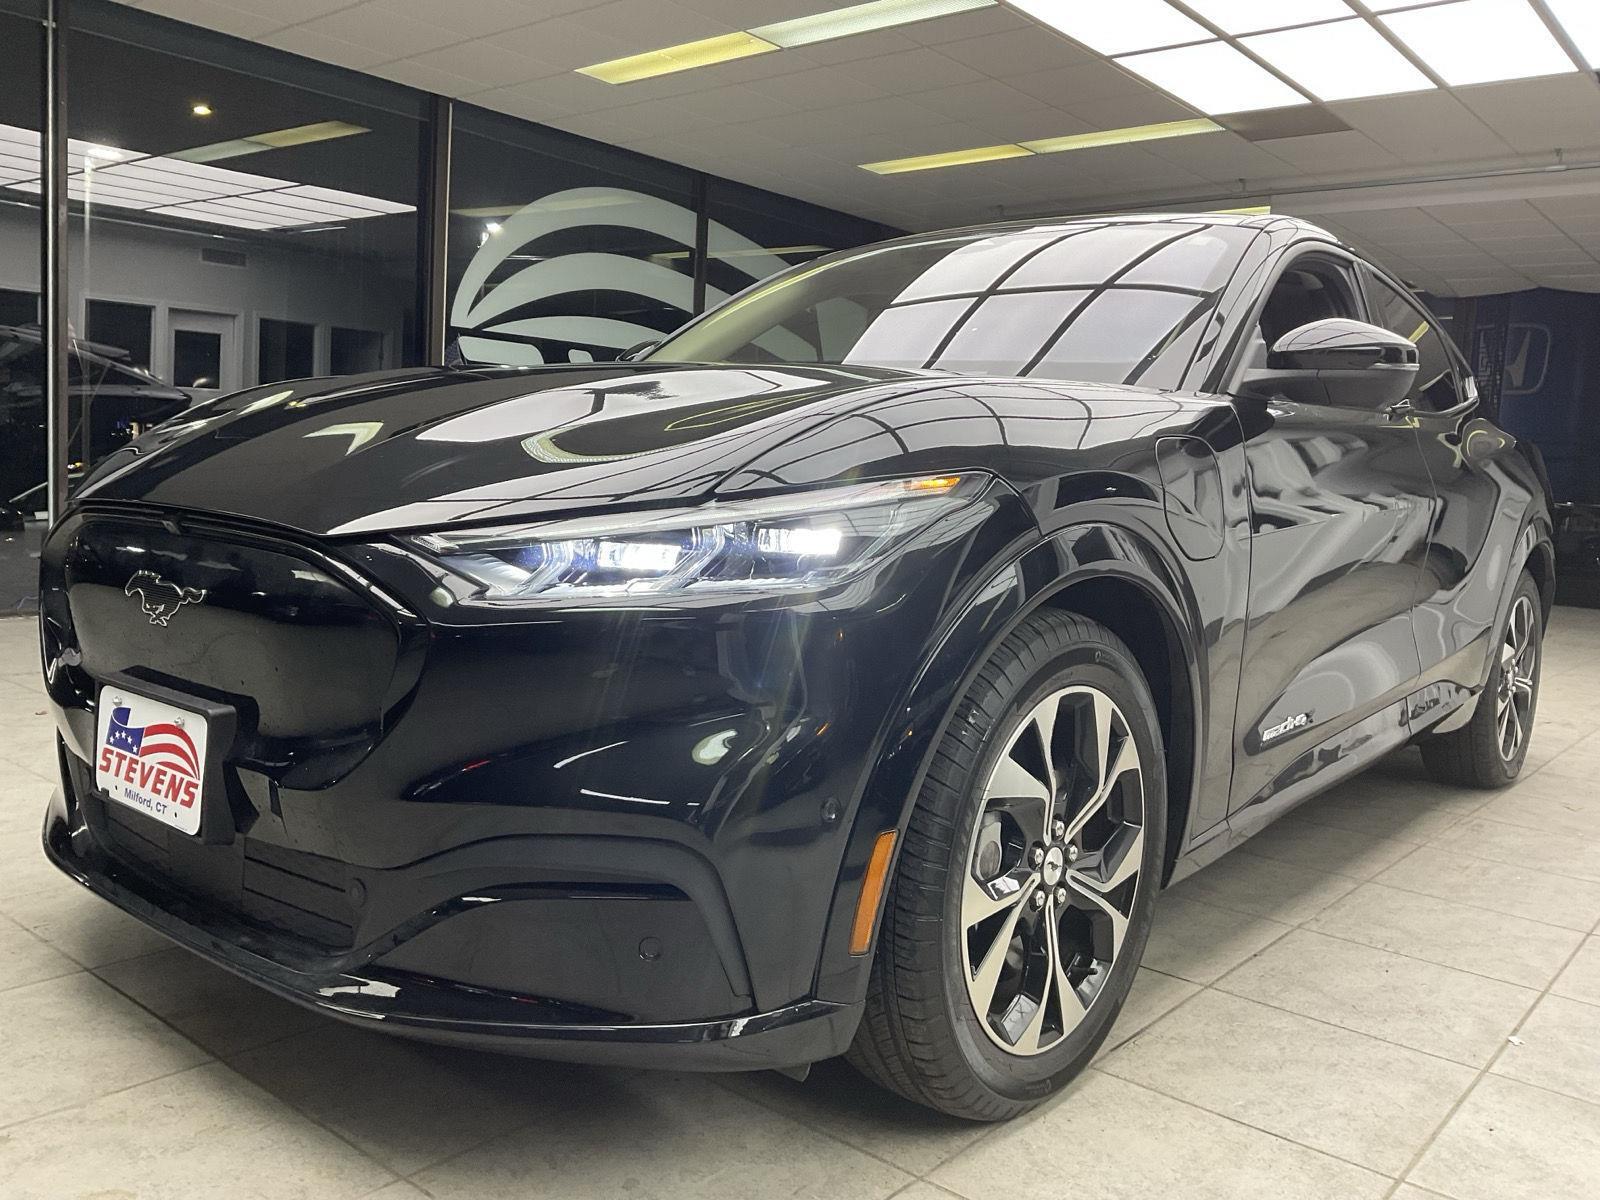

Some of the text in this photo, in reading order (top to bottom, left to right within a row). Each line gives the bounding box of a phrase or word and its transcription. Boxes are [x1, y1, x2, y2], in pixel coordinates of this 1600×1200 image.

[98, 747, 200, 809] STEVENS
[124, 787, 168, 815] Milford, CT
